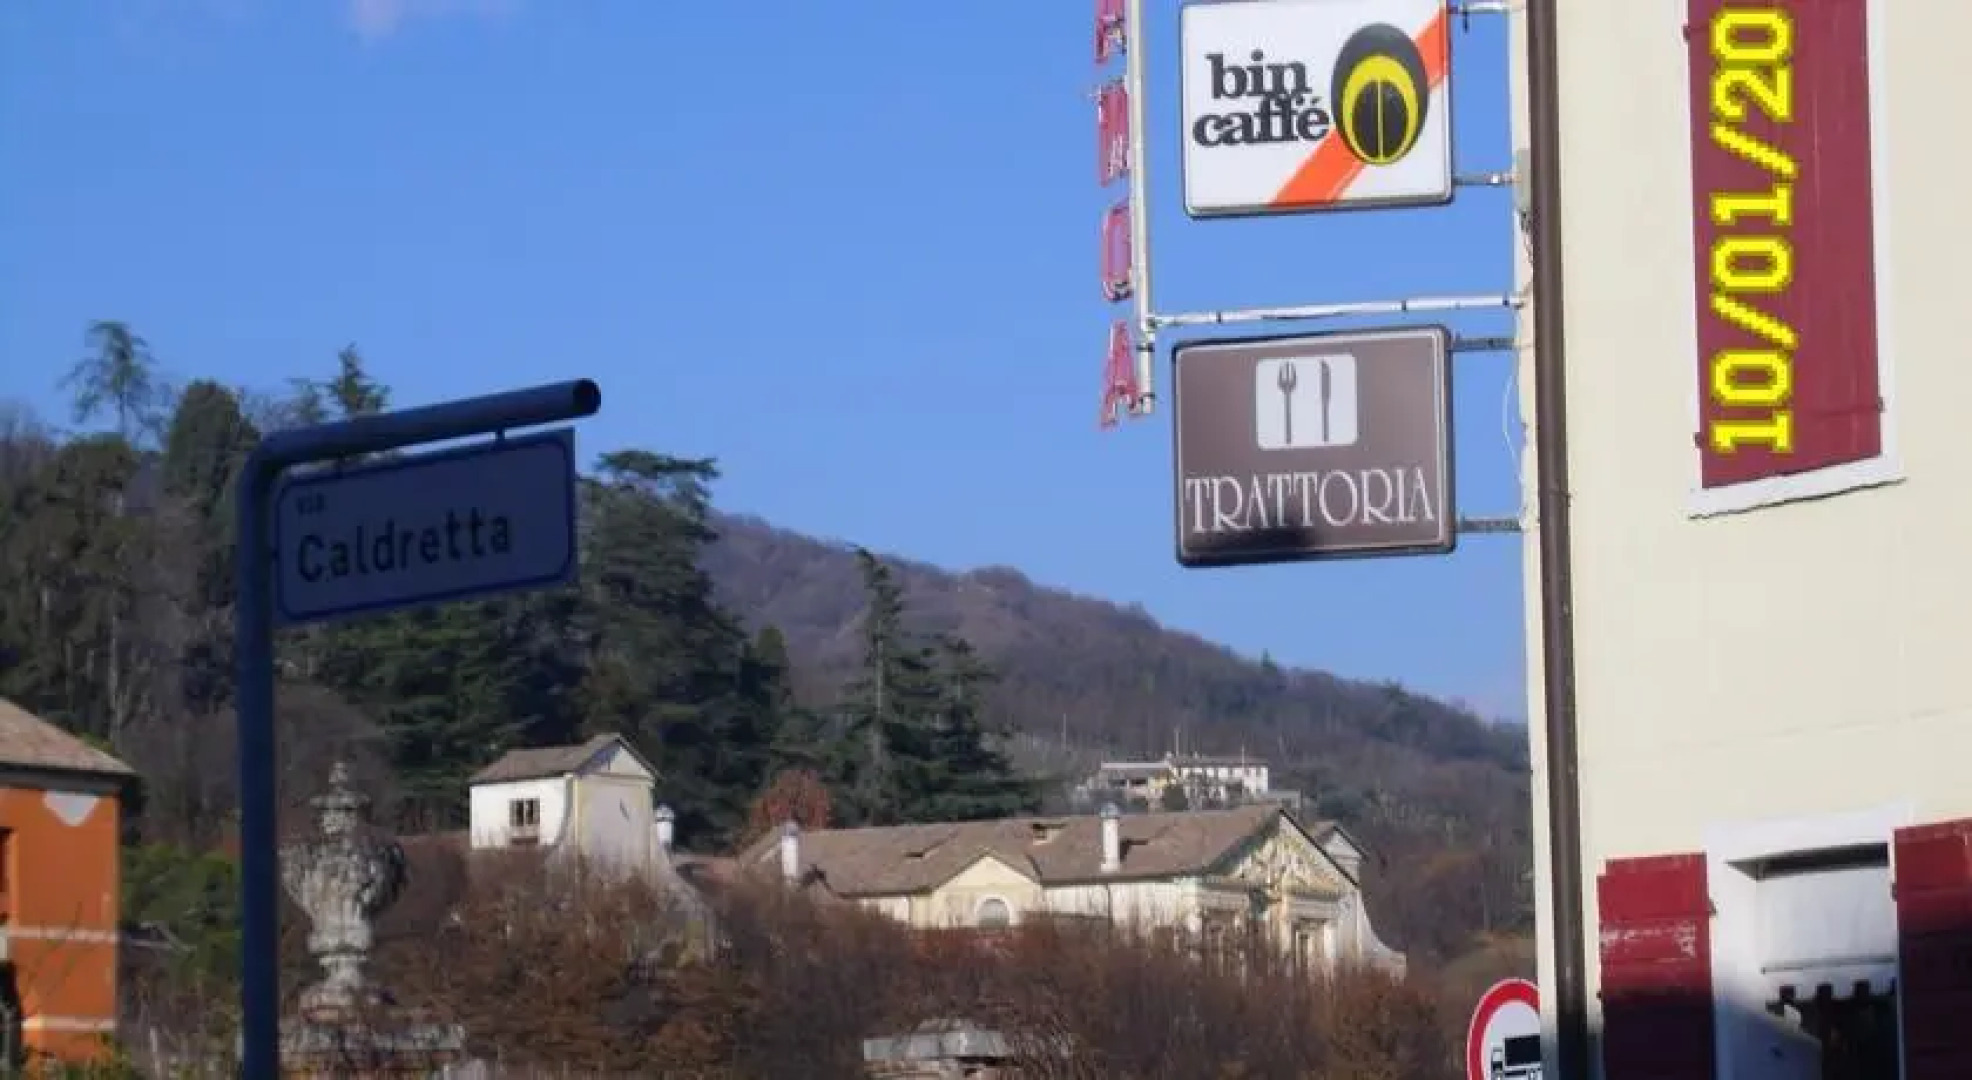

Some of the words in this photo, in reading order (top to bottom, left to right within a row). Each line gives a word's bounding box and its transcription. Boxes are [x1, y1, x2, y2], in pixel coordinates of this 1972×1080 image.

[1205, 49, 1313, 99] bin
[1193, 94, 1330, 147] caffé
[1185, 466, 1436, 533] TRATTORIA
[298, 507, 513, 583] Caldretta
